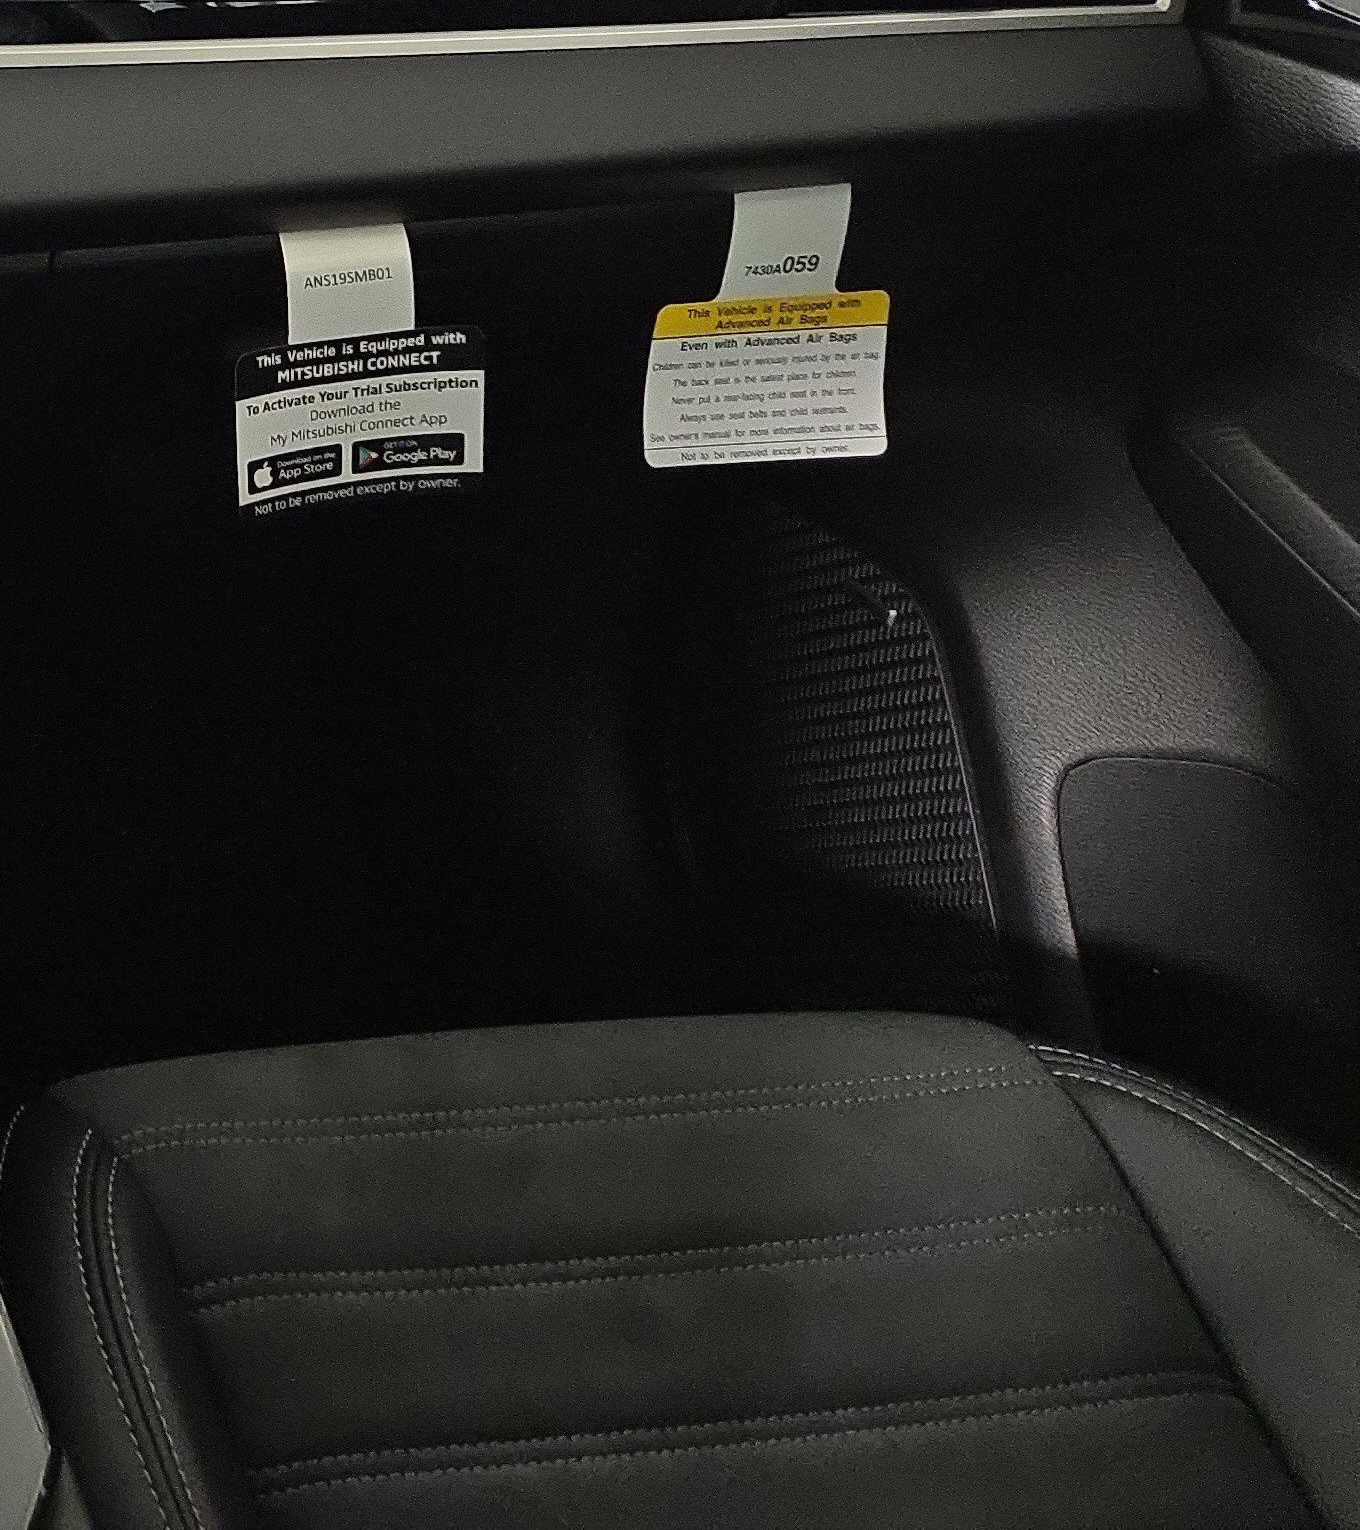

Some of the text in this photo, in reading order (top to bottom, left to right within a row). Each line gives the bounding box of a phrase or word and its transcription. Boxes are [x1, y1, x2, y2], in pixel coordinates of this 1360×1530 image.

[304, 267, 393, 290] ANS19SMB01
[687, 308, 710, 319] This
[718, 305, 758, 317] Vehicle
[763, 304, 772, 313] is
[780, 300, 832, 314] Equipped
[716, 314, 828, 330] Advanced Air Bags
[256, 332, 467, 369] This Vehicle is Equipped with
[680, 331, 858, 351] Even with Advanced Air Bags
[277, 351, 441, 384] MITSUBISHI CONNECT
[246, 376, 479, 418] To Activate Your Trial Subscription
[310, 399, 402, 421] Download the
[271, 414, 448, 448] My Mitsubishi Connect App
[383, 447, 457, 464] Google Play
[278, 461, 334, 480] App Store
[254, 477, 462, 516] Not to be removed except by owner.
